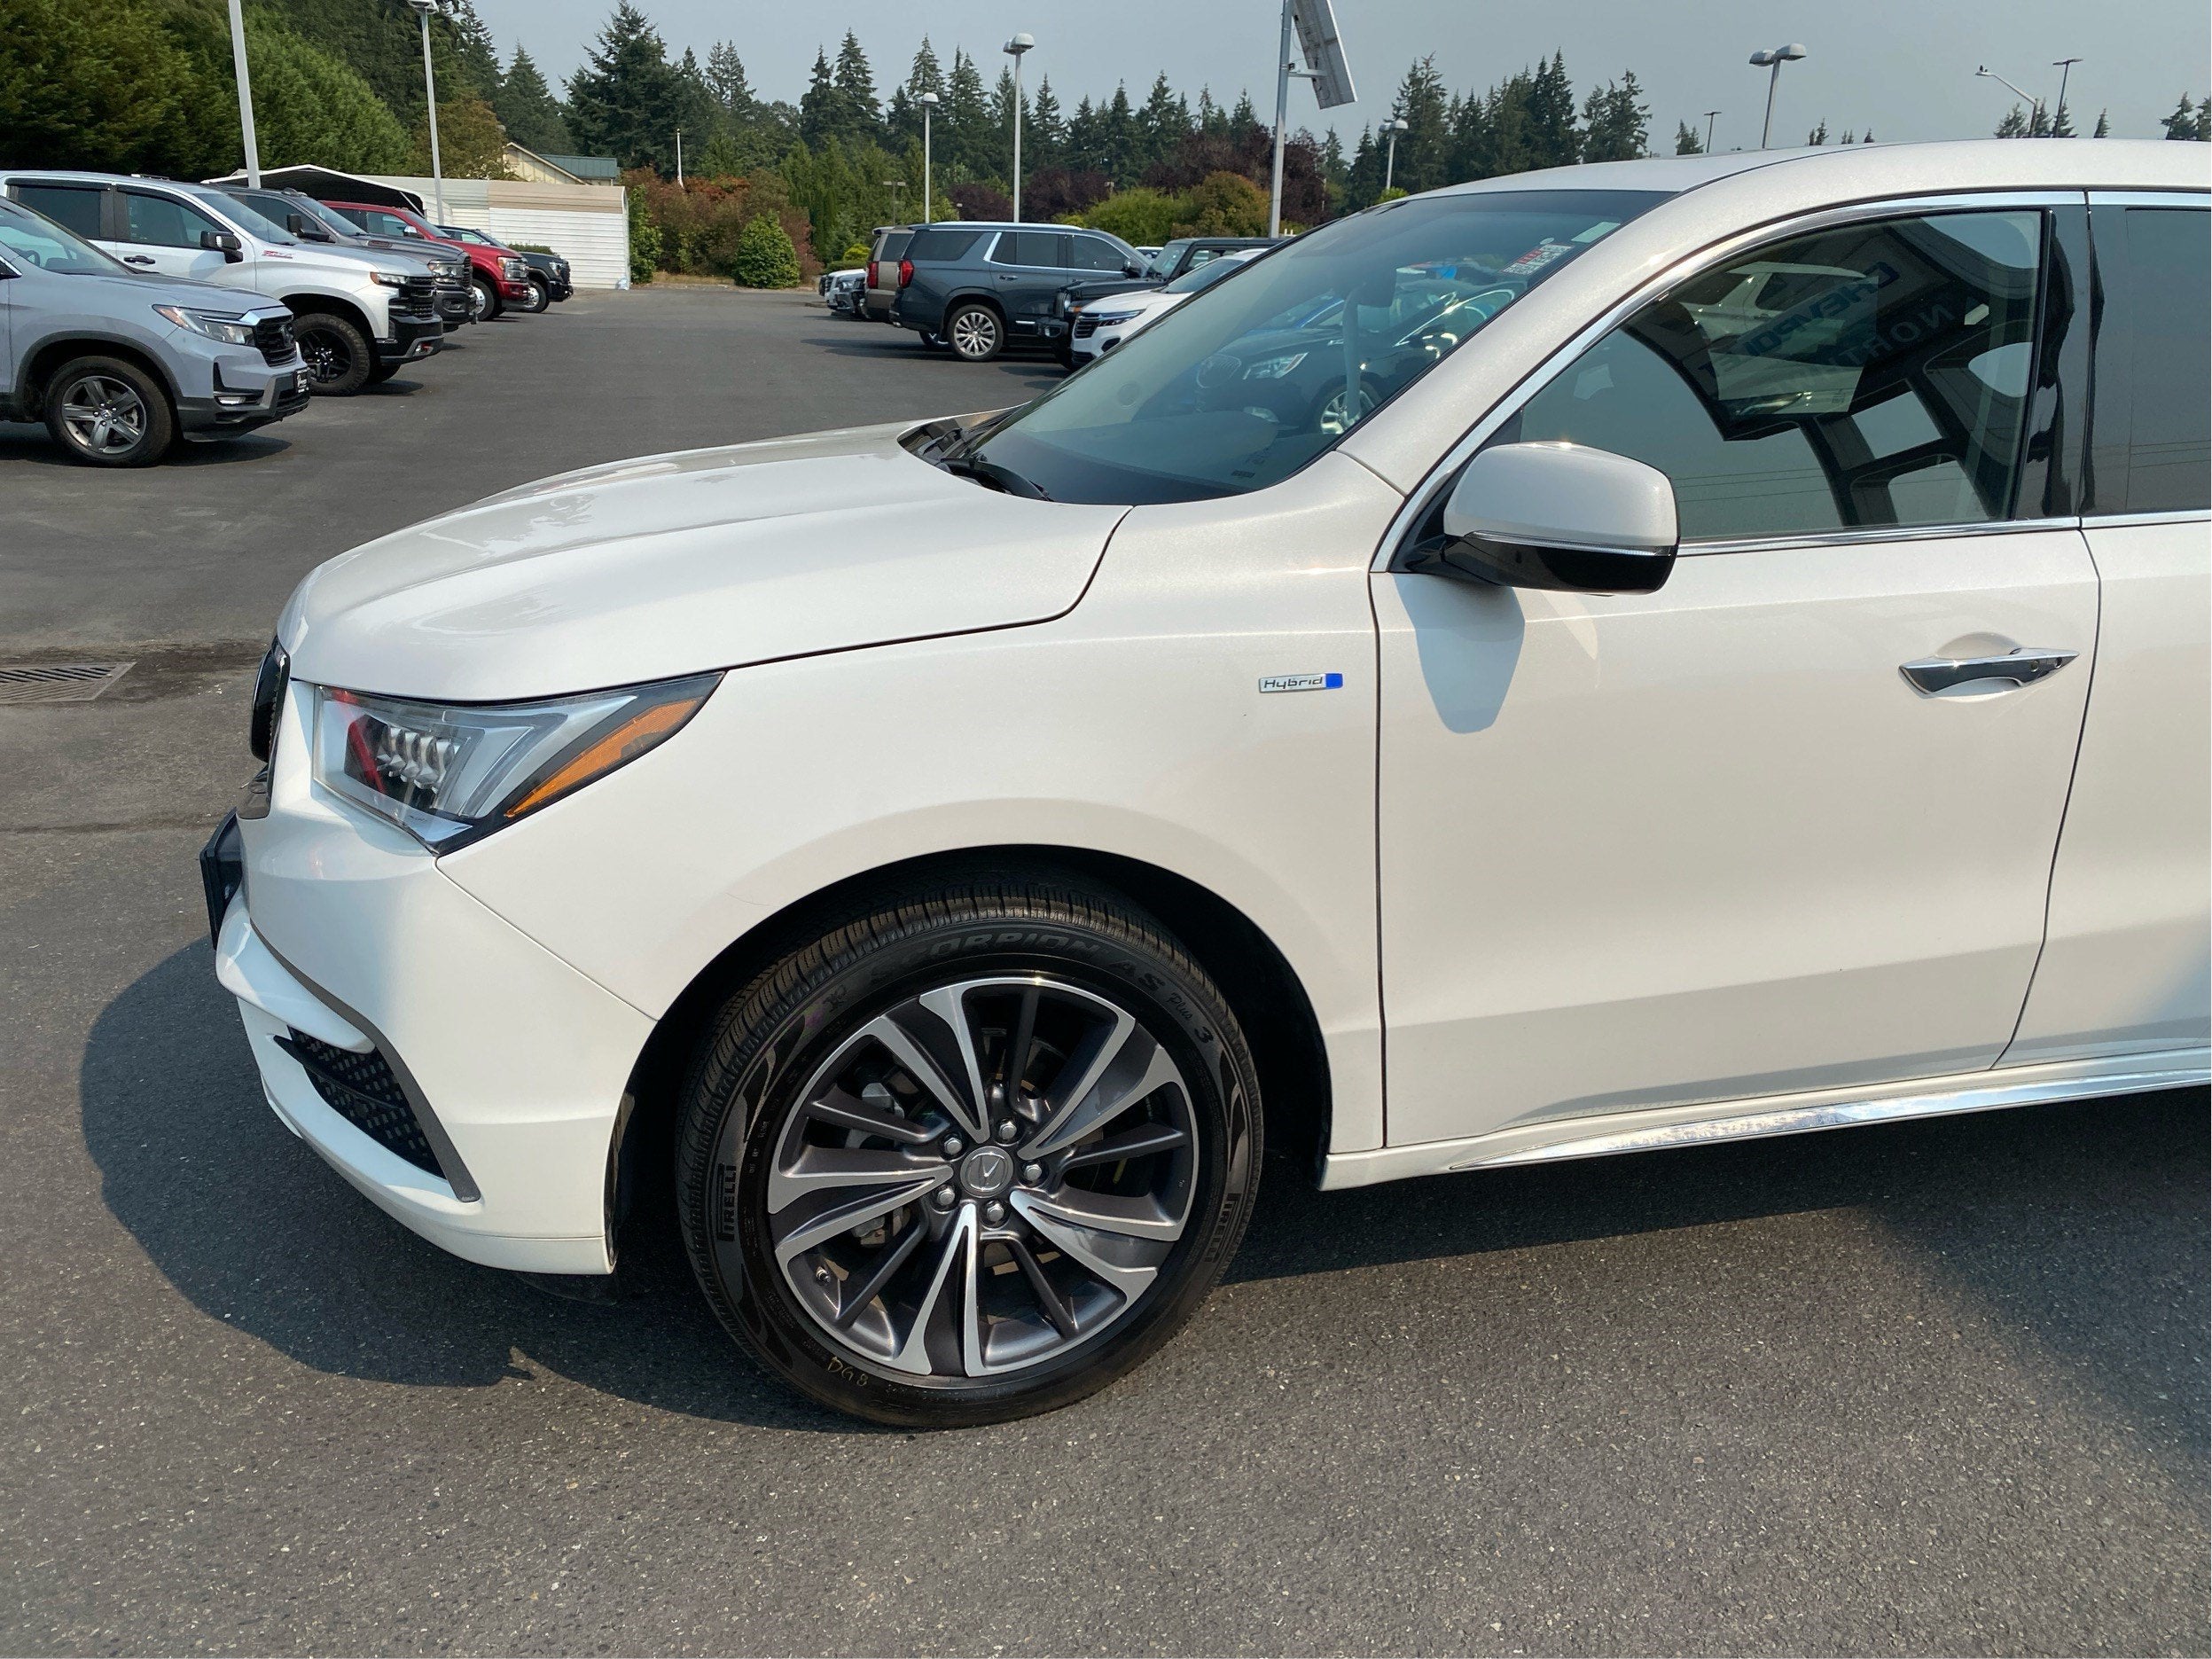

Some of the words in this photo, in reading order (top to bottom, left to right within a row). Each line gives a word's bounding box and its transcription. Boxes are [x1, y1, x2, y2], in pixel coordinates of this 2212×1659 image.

[1263, 677, 1323, 690] Hybrid
[1166, 992, 1193, 1021] Plus
[1193, 1026, 1215, 1045] 3
[716, 1162, 737, 1241] PIRELLI
